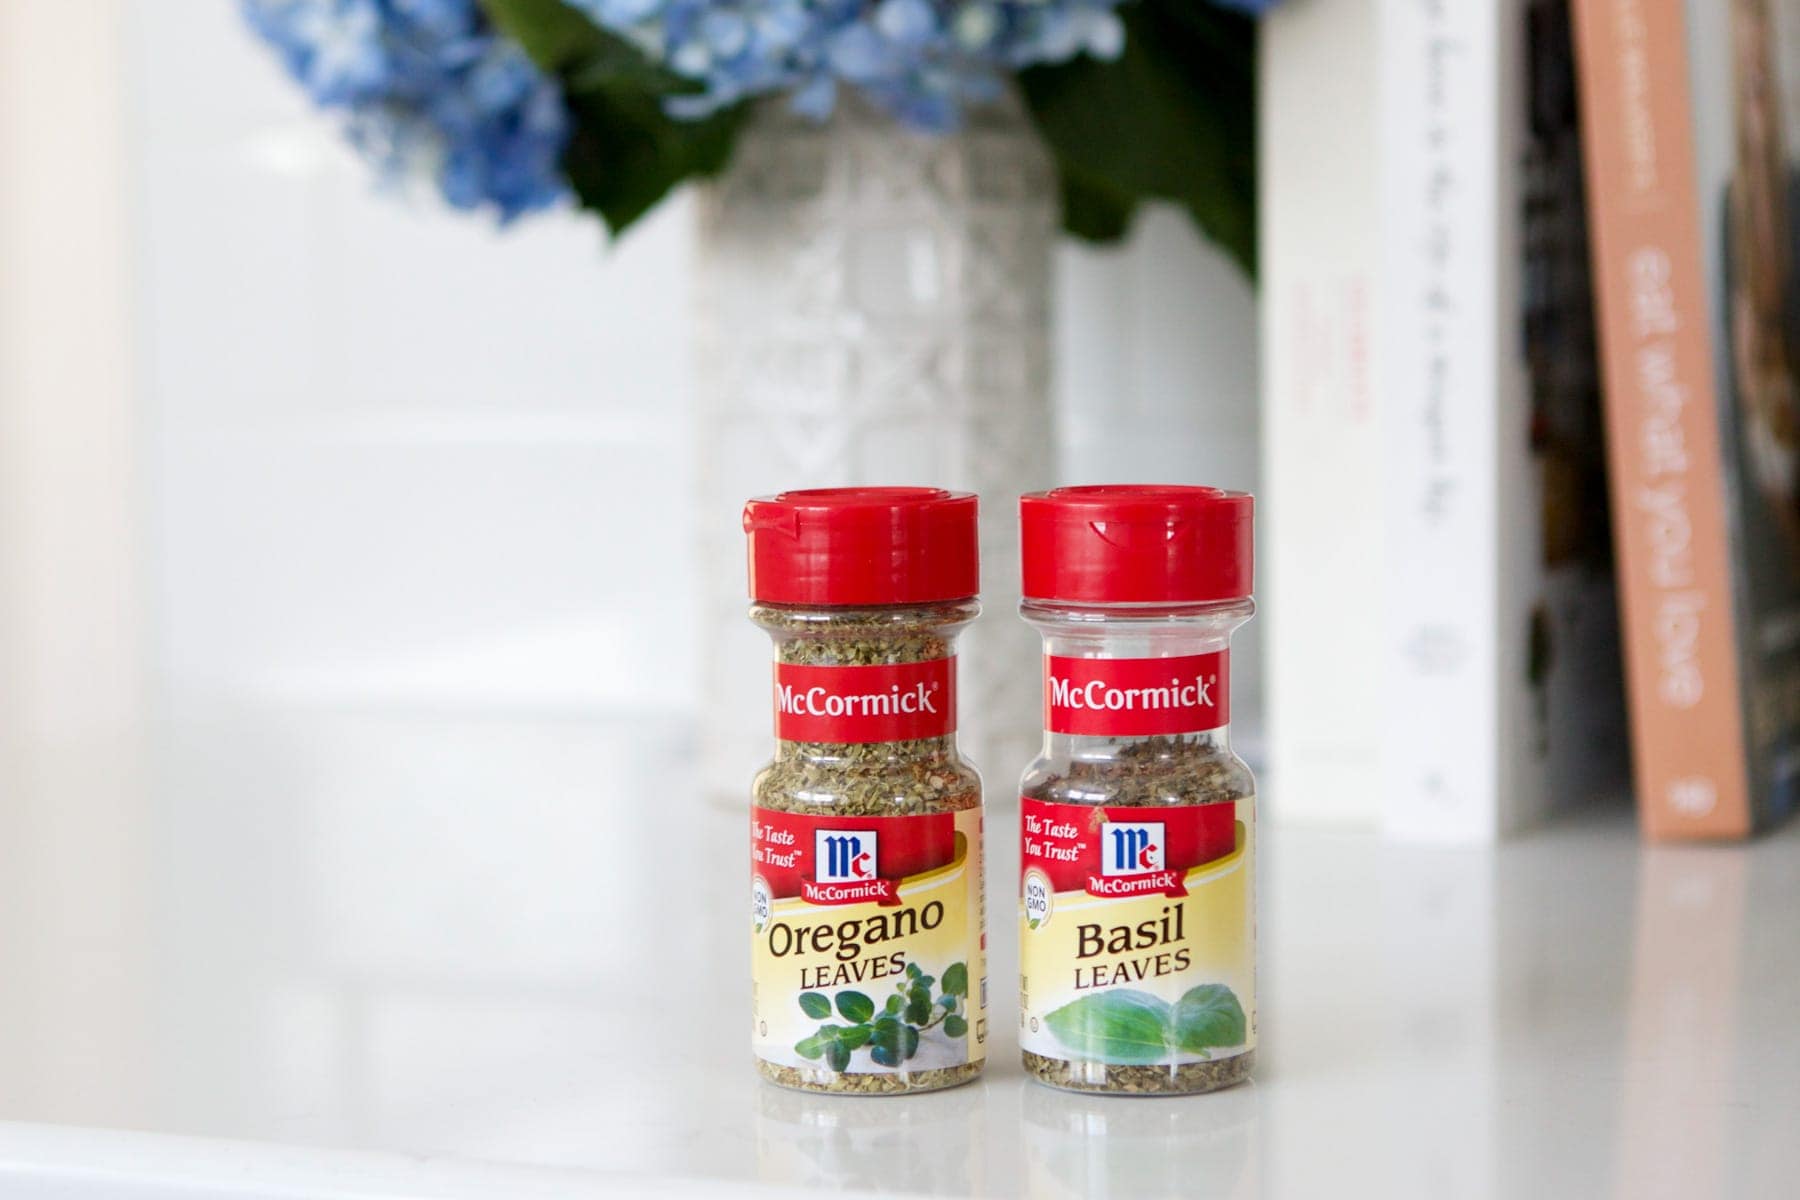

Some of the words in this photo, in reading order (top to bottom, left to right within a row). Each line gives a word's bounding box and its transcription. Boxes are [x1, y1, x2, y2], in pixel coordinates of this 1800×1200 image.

[1634, 484, 1692, 587] you
[1656, 590, 1706, 708] love
[764, 825, 795, 845] Taste
[1025, 815, 1041, 834] The
[1043, 818, 1078, 839] Taste
[1025, 837, 1041, 857] You
[1027, 885, 1045, 899] NON
[1027, 897, 1047, 912] GMO
[769, 900, 944, 961] Oregano
[1076, 902, 1185, 960] Basil
[800, 951, 906, 990] LEAVES
[1073, 948, 1191, 990] LEAVES
